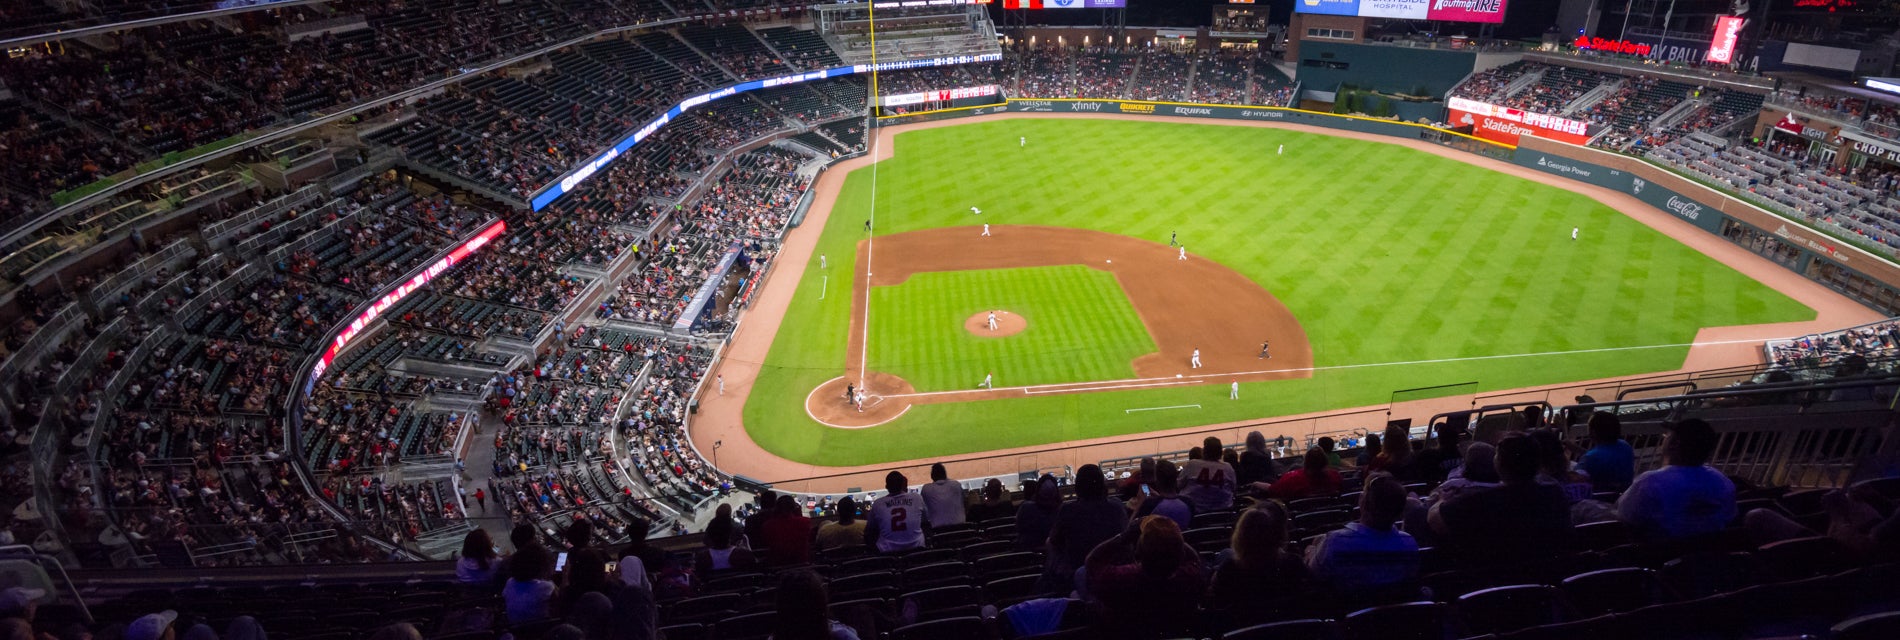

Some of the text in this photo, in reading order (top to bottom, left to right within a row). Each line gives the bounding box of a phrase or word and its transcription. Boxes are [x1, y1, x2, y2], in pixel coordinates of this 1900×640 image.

[1668, 46, 1697, 63] BALL
[1071, 102, 1102, 111] xfinity
[1120, 103, 1156, 111] QUIKRETE
[1174, 106, 1213, 115] EQUIFAX
[1801, 126, 1828, 140] LIGHT
[1853, 141, 1885, 157] CHOP
[1547, 161, 1591, 177] Georgia Power
[1198, 467, 1224, 487] 44
[891, 507, 907, 531] 2
